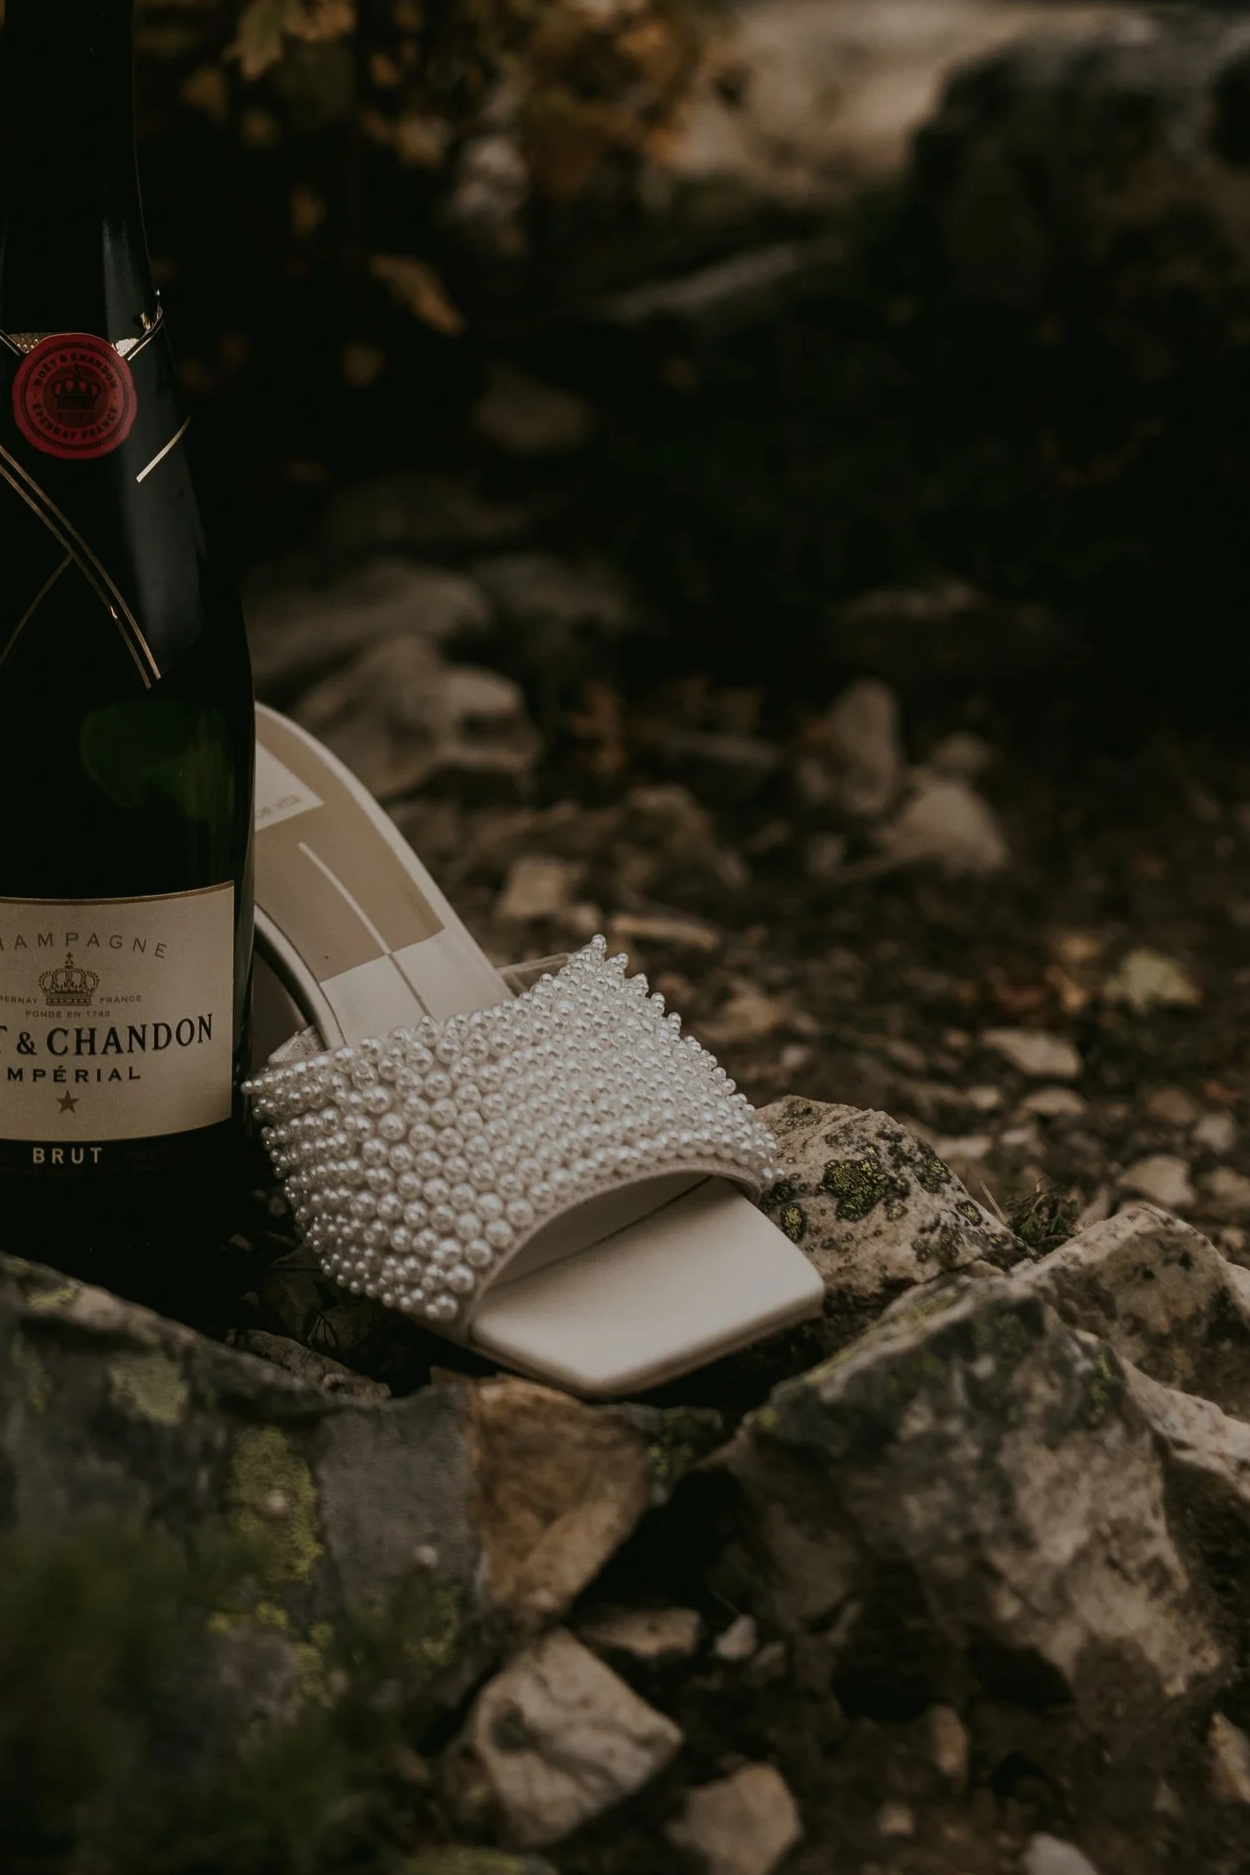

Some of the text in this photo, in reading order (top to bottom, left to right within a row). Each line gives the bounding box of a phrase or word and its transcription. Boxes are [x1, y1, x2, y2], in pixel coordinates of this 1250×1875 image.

[99, 993, 142, 1004] FRANCE
[67, 1010, 81, 1018] EN
[15, 1031, 37, 1055] &
[46, 1012, 213, 1057] CHANDON
[32, 1147, 103, 1164] BRUT
